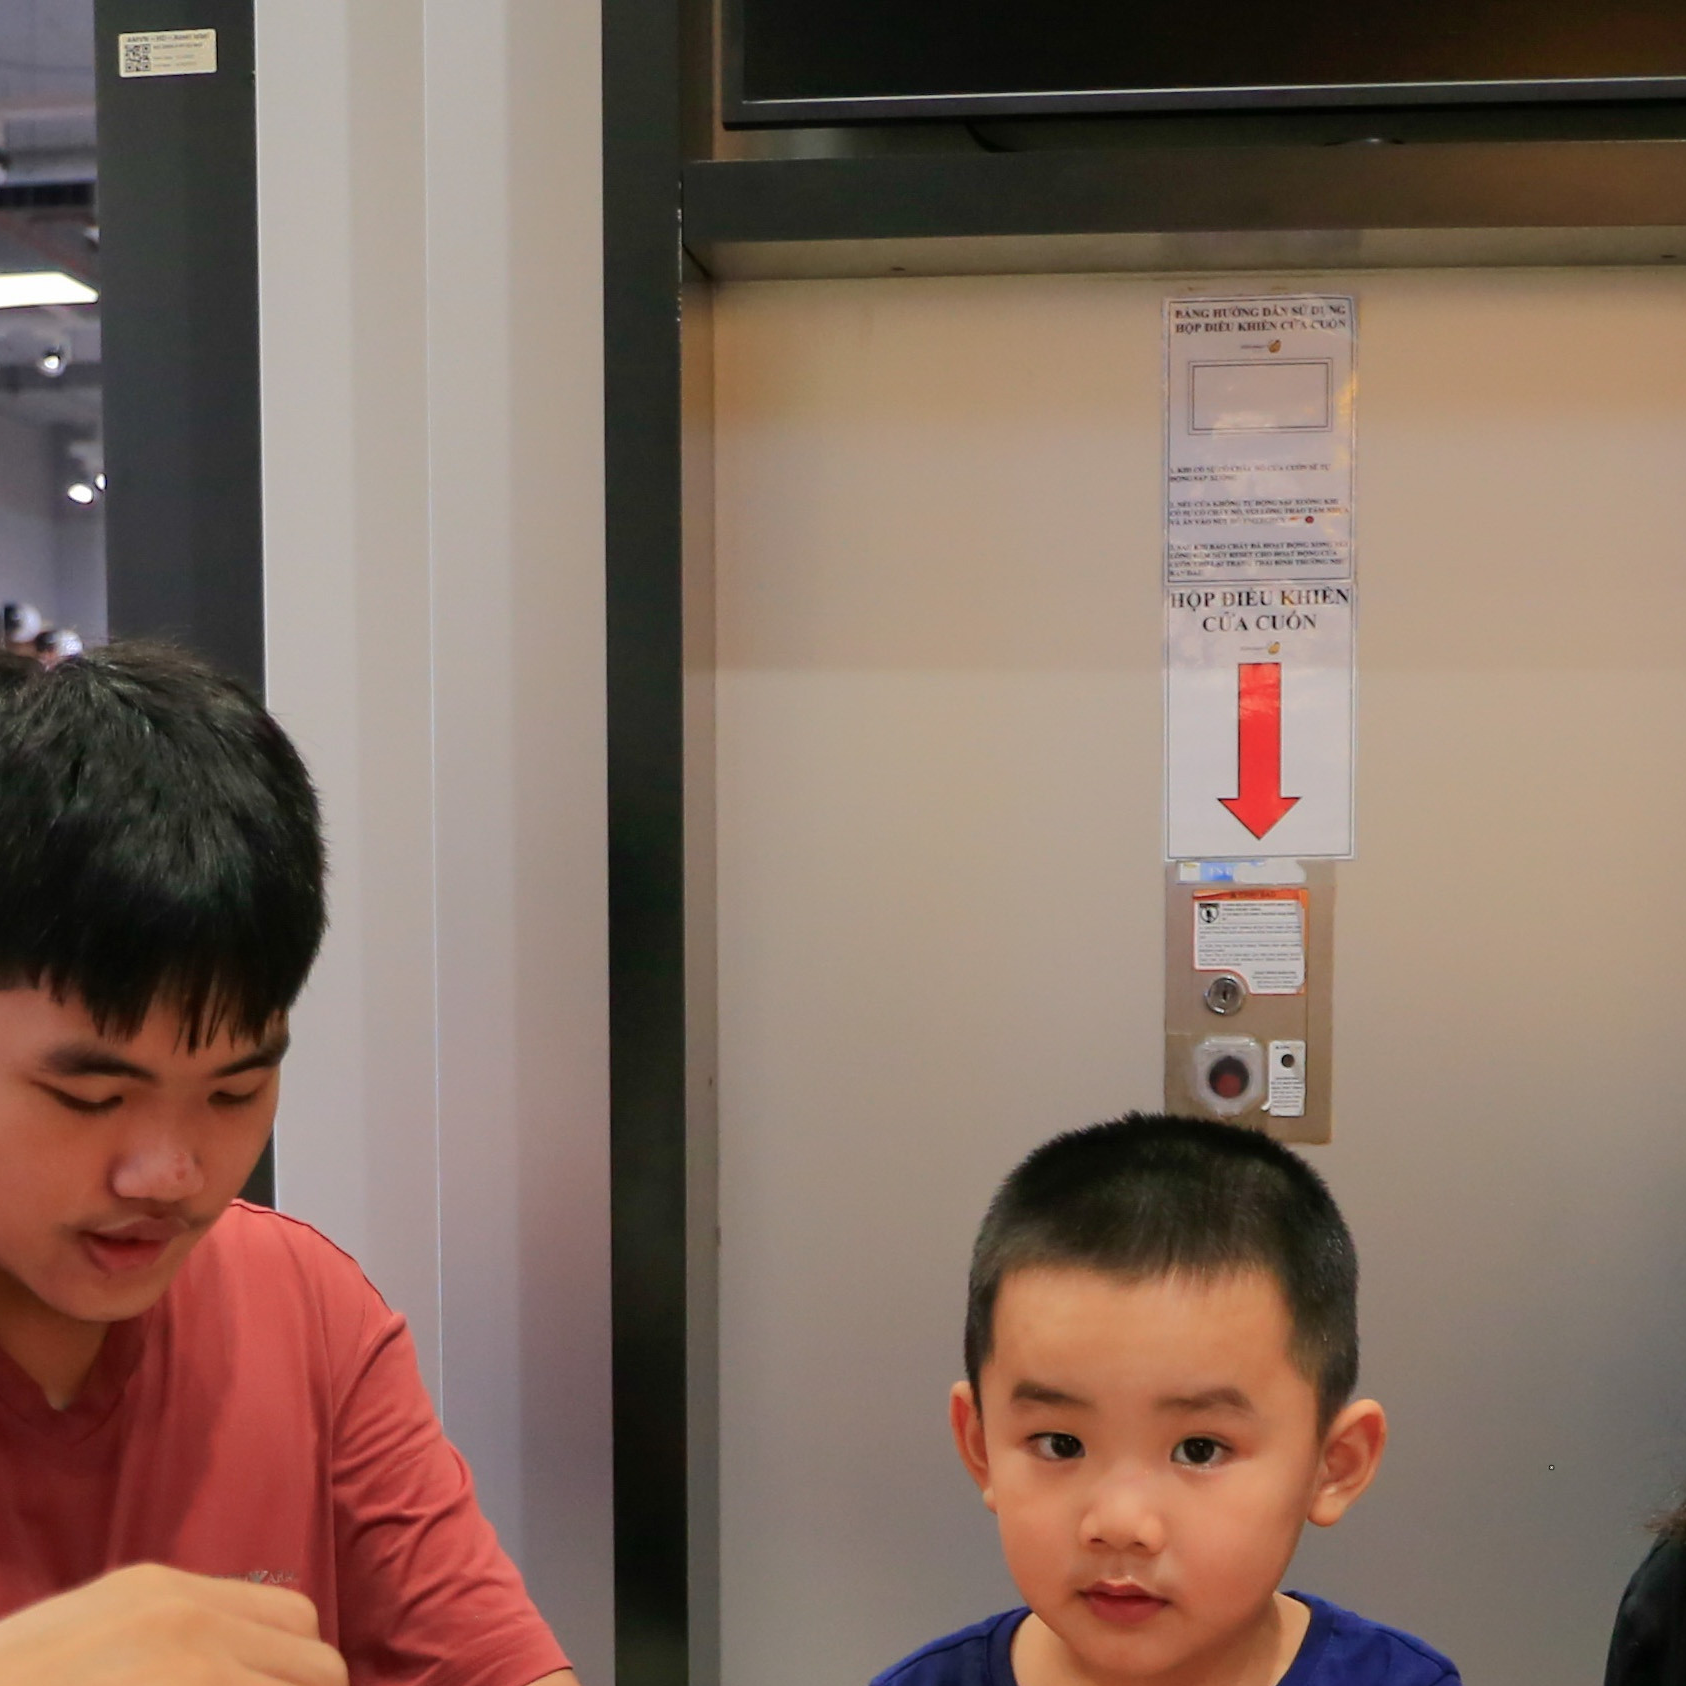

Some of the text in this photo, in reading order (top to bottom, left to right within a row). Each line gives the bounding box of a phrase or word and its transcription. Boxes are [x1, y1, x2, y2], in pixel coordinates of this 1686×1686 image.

[1170, 590, 1215, 611] HỘP
[1202, 610, 1318, 632] CỬA CUỐN
